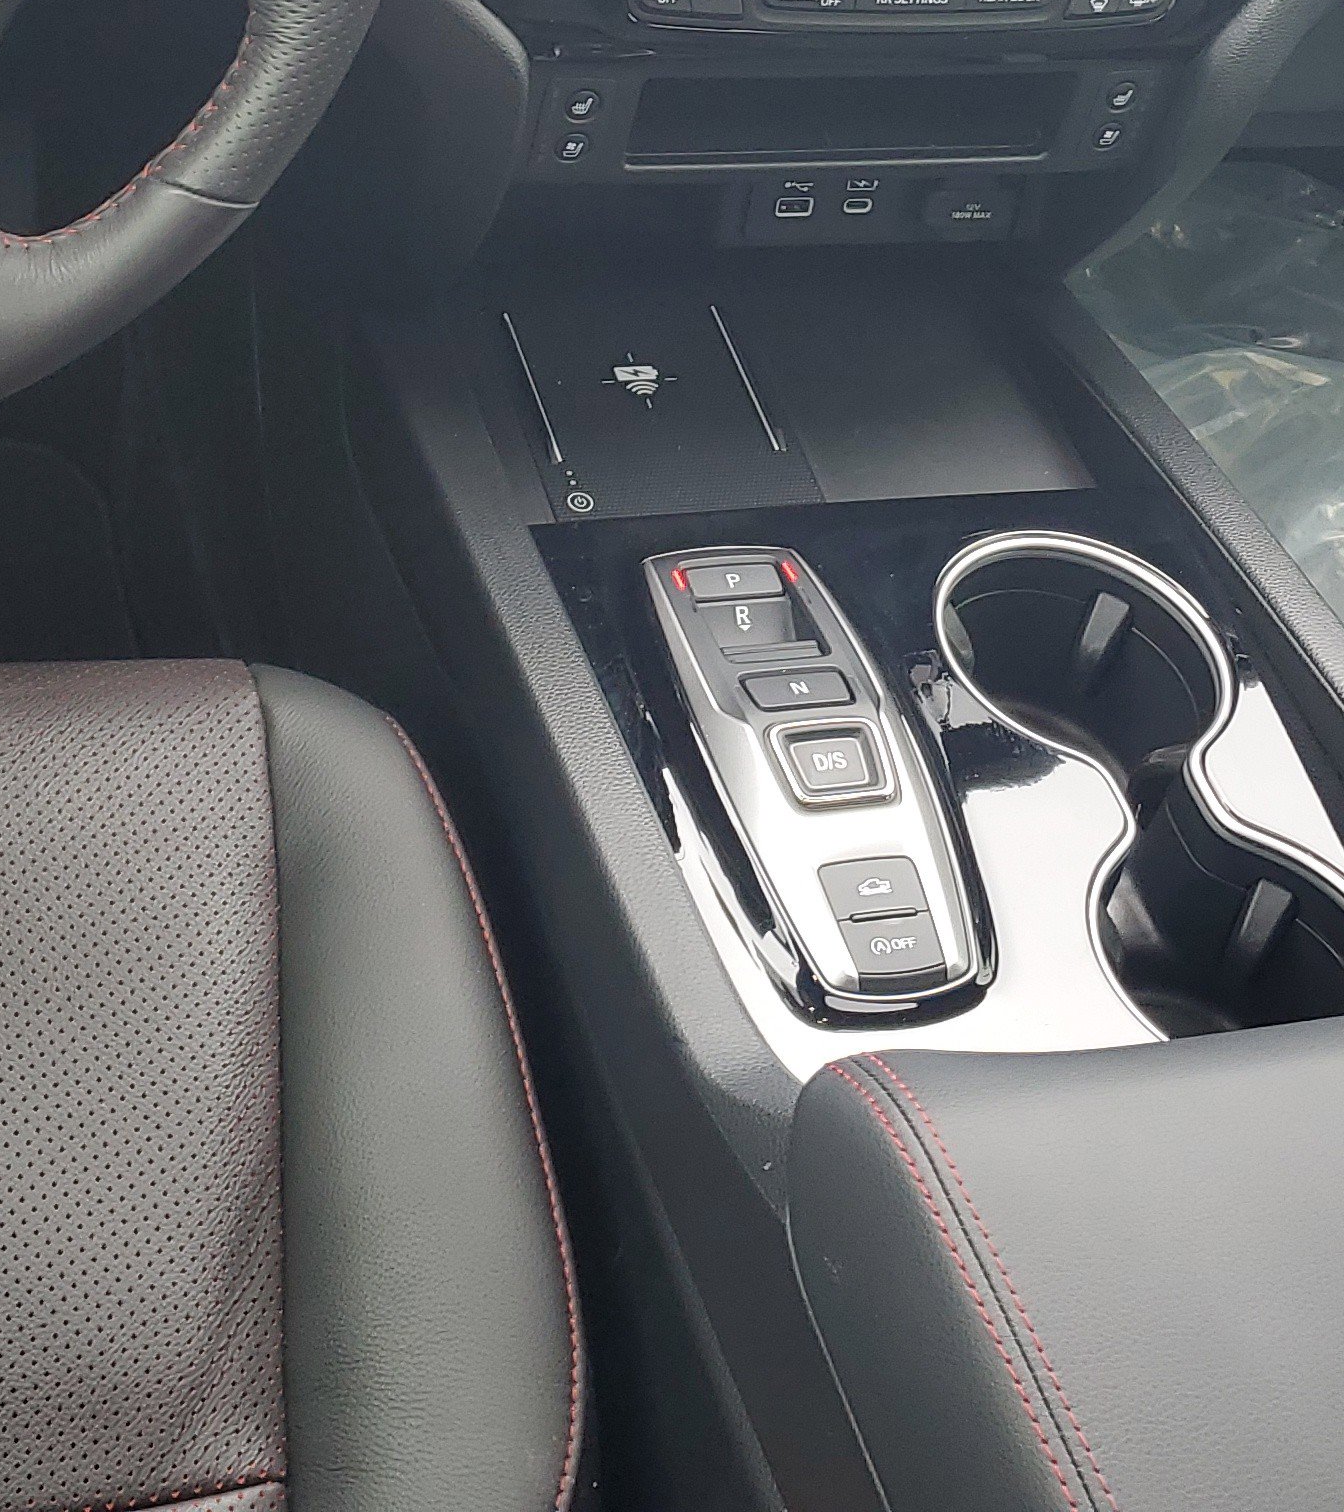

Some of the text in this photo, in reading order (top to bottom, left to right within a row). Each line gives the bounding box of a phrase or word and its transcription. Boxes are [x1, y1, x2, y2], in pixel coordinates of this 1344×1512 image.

[725, 573, 741, 589] P
[735, 605, 751, 626] R
[789, 681, 810, 696] N
[812, 751, 849, 772] D/S
[890, 936, 917, 950] OFF
